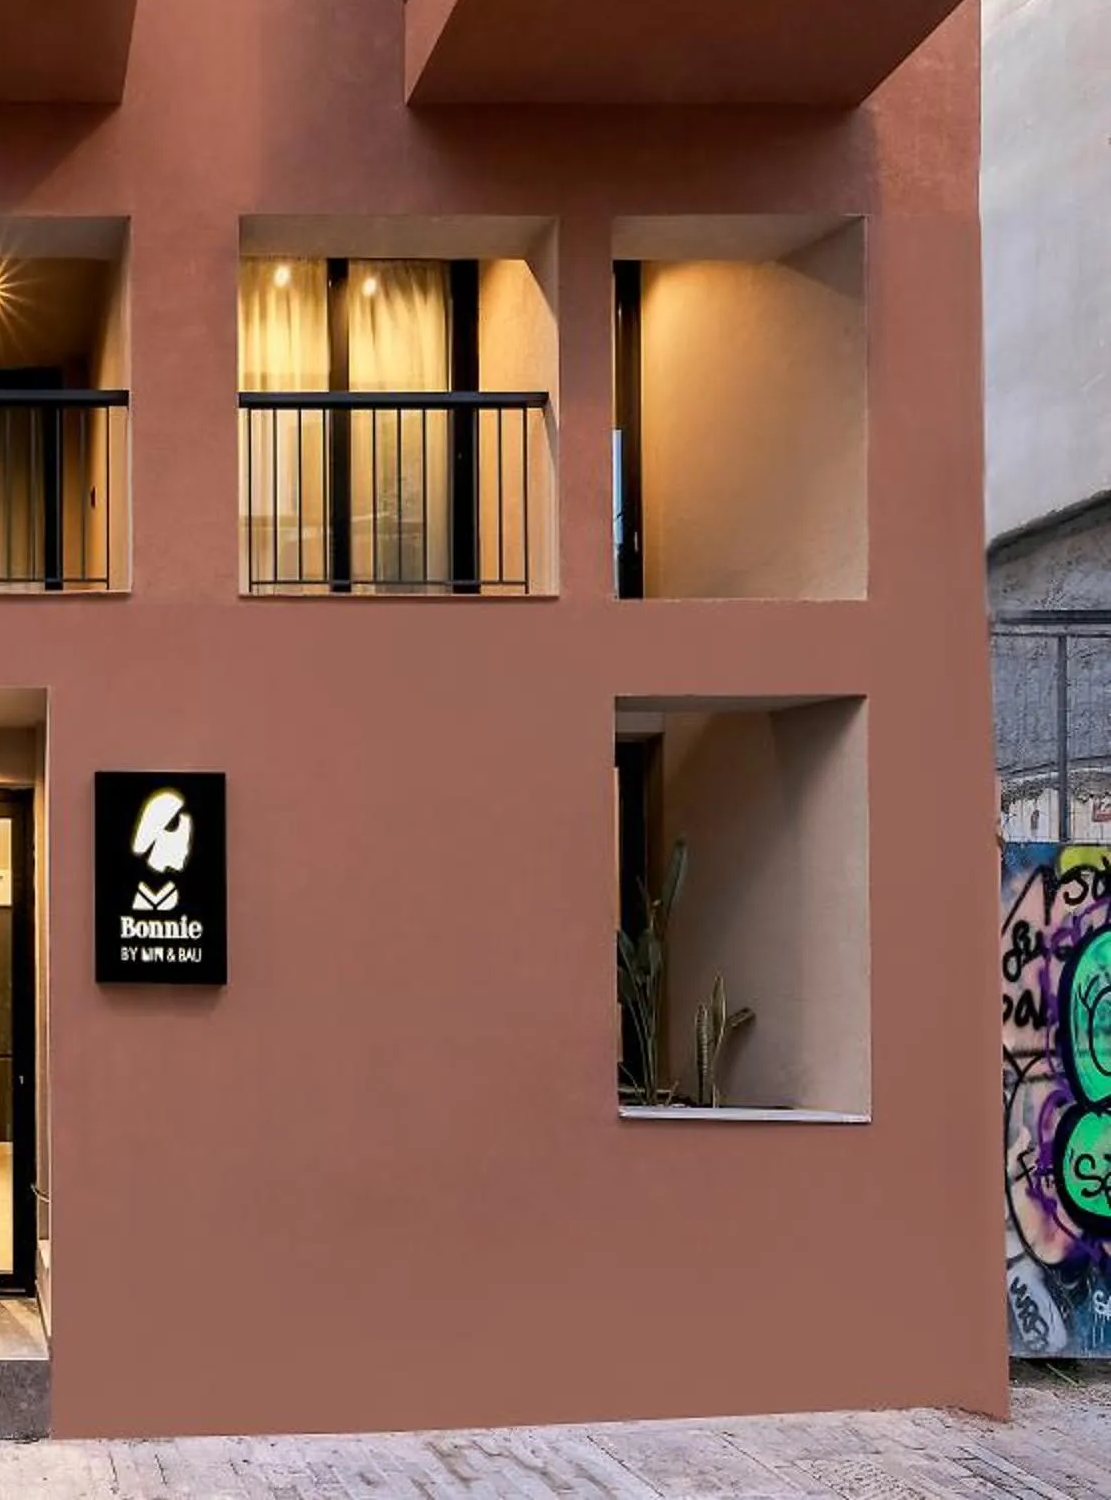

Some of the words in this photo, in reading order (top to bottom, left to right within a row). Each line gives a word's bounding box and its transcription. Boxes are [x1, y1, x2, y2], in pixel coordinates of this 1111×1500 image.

[120, 915, 203, 939] Bonnie
[120, 946, 138, 962] BY
[166, 946, 176, 962] &
[178, 947, 202, 963] BAU
